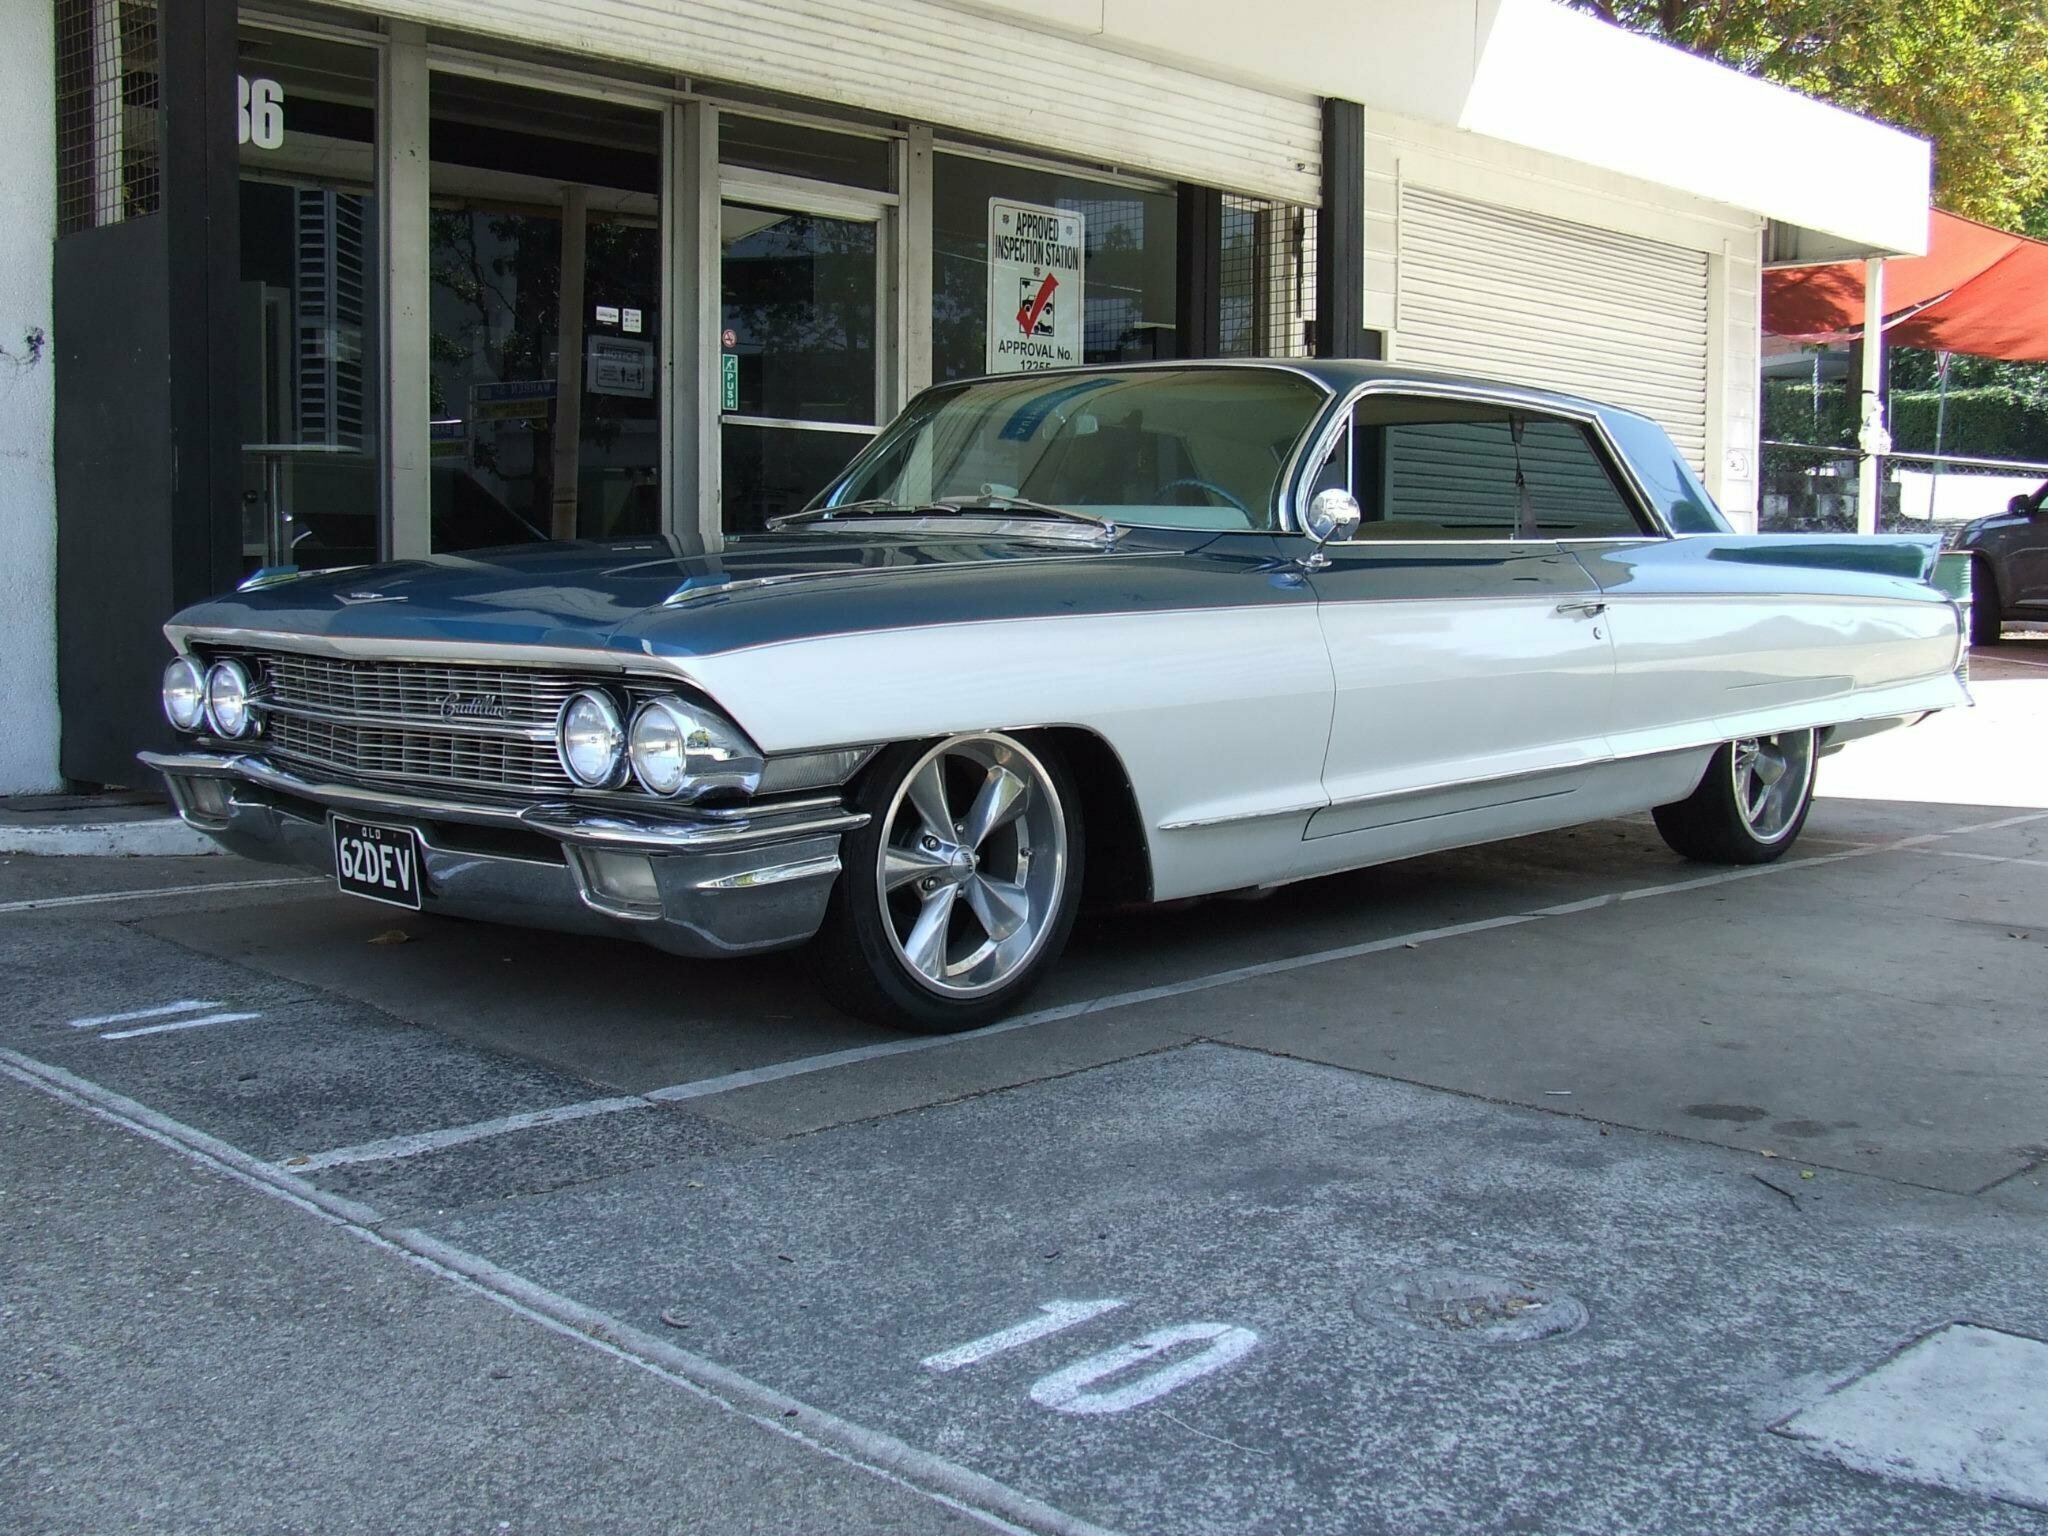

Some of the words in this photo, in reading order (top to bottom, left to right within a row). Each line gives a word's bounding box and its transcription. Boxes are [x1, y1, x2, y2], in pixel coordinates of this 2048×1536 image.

[1016, 212, 1059, 242] APPROVED
[995, 234, 1043, 266] INSPECTION
[1045, 242, 1079, 270] STATION
[998, 339, 1054, 359] APPROVAL
[1057, 346, 1073, 360] No.
[436, 692, 512, 723] Cadillac
[362, 826, 381, 840] QLD
[340, 837, 410, 891] 62DEV
[919, 1299, 1257, 1414] 10
